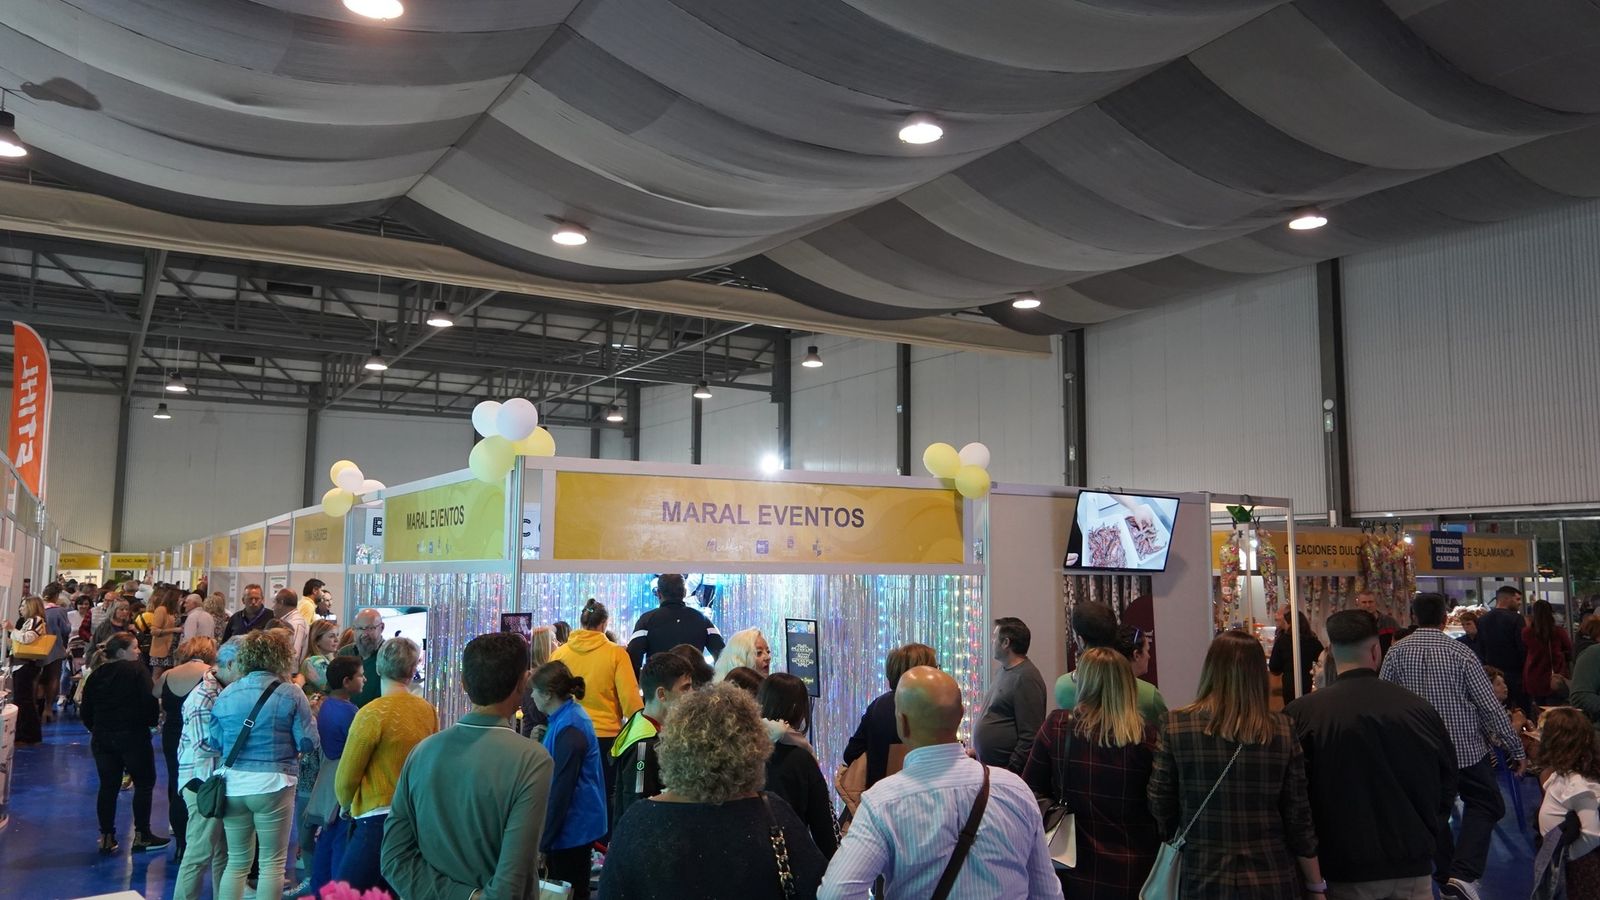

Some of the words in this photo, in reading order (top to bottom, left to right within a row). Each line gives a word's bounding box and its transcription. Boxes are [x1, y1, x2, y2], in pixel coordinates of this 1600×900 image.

[406, 511, 429, 530] MARAL
[431, 505, 465, 528] EVENTOS
[662, 501, 750, 525] MARAL
[758, 504, 865, 528] EVENTOS
[1284, 544, 1337, 555] CEACIONES
[1339, 545, 1361, 556] DULC
[1474, 547, 1515, 557] SALAMANCA
